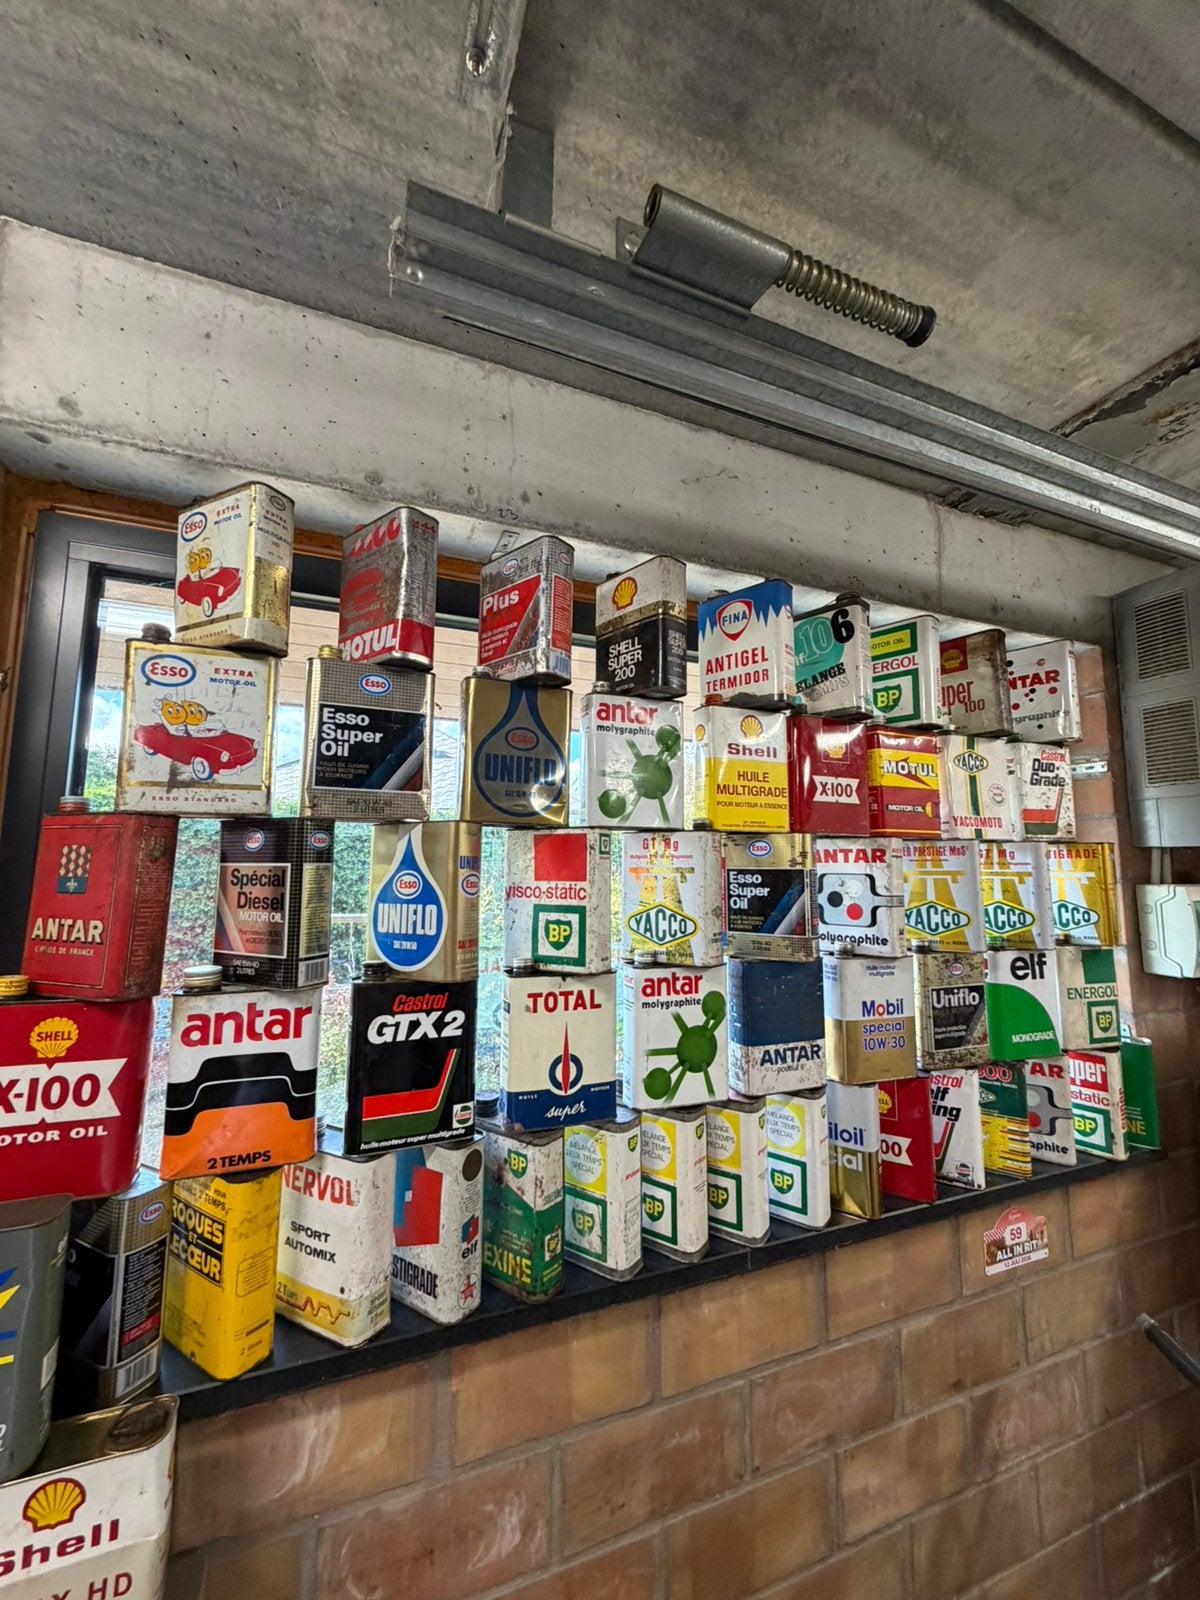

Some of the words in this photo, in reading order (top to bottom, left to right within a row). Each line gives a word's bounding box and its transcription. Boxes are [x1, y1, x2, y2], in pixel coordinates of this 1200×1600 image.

[482, 589, 520, 617] Plus
[722, 609, 748, 626] FINA
[340, 623, 396, 661] MOTUL
[608, 636, 642, 658] SHELL
[608, 649, 642, 671] SUPER
[705, 645, 769, 676] ANTIGEL
[209, 676, 241, 686] MOTOR
[214, 666, 254, 678] EXTRA
[614, 665, 636, 682] 200
[705, 668, 769, 694] TERMIDOR
[795, 662, 846, 694] ELANGE
[877, 689, 899, 708] BP
[962, 698, 986, 714] 100
[322, 706, 370, 726] Esso
[596, 701, 658, 725] antar
[1012, 708, 1070, 724] graphite
[321, 723, 383, 744] Super
[596, 723, 656, 738] molygraphite
[320, 739, 349, 757] Oil
[727, 742, 778, 759] Shell
[484, 753, 558, 787] UNIFLO
[738, 770, 769, 783] HUILE
[882, 760, 937, 778] MOTUL
[183, 795, 237, 803] STANDARD
[716, 784, 787, 799] MULTIGRADE
[887, 804, 914, 813] MOTOR
[952, 815, 1003, 829] YACCOMOTO
[913, 845, 948, 858] PRESTIGE
[230, 867, 286, 891] Spécial
[728, 870, 763, 886] Esso
[236, 890, 284, 912] Diesel
[504, 883, 587, 901] visco-static
[728, 883, 771, 899] Super
[728, 896, 749, 911] Oil
[240, 910, 268, 923] MOTOR
[269, 911, 284, 924] OIL
[376, 902, 438, 936] UNIFLO
[634, 907, 688, 942] YACCO
[904, 903, 961, 933] YACCO
[31, 917, 104, 944] ANTAR
[547, 924, 571, 943] BP
[1010, 952, 1047, 981] elf
[641, 970, 704, 998] antar
[1066, 985, 1120, 1001] ENERGOL
[391, 991, 449, 1013] Castrol
[527, 988, 603, 1014] TOTAL
[641, 997, 702, 1011] molygraphite
[862, 998, 905, 1018] Mobil
[932, 988, 980, 1009] Uniflo
[180, 1001, 313, 1048] antar
[862, 1020, 906, 1036] special
[1097, 1014, 1112, 1028] BP
[35, 1029, 74, 1042] SHELL
[863, 1035, 906, 1051] 10W-30
[1011, 1030, 1055, 1044] MONOGRADE
[759, 1043, 822, 1067] ANTAR
[544, 1099, 587, 1121] super
[69, 1124, 109, 1140] OIL
[780, 1121, 801, 1134] TEMPS
[1074, 1116, 1097, 1133] BP
[360, 1139, 380, 1150] huile
[379, 1135, 408, 1148] moteur
[406, 1133, 428, 1146] super
[427, 1127, 466, 1141] multigrade
[206, 1156, 220, 1171] 2
[218, 1149, 273, 1169] TEMPS
[509, 1152, 527, 1173] BP
[773, 1172, 793, 1190] BP
[204, 1191, 226, 1212] TEMPS
[708, 1186, 727, 1205] BP
[645, 1196, 663, 1217] BP
[574, 1211, 594, 1232] BP
[187, 1231, 198, 1244] ET
[290, 1220, 331, 1245] SPORT
[1009, 1226, 1023, 1241] 59
[284, 1235, 337, 1264] AUTOMIX
[461, 1239, 480, 1260] elf
[996, 1248, 1013, 1262] ALL
[1024, 1239, 1038, 1253] RIT
[0, 1518, 120, 1578] Shell
[87, 1572, 133, 1600] HD
